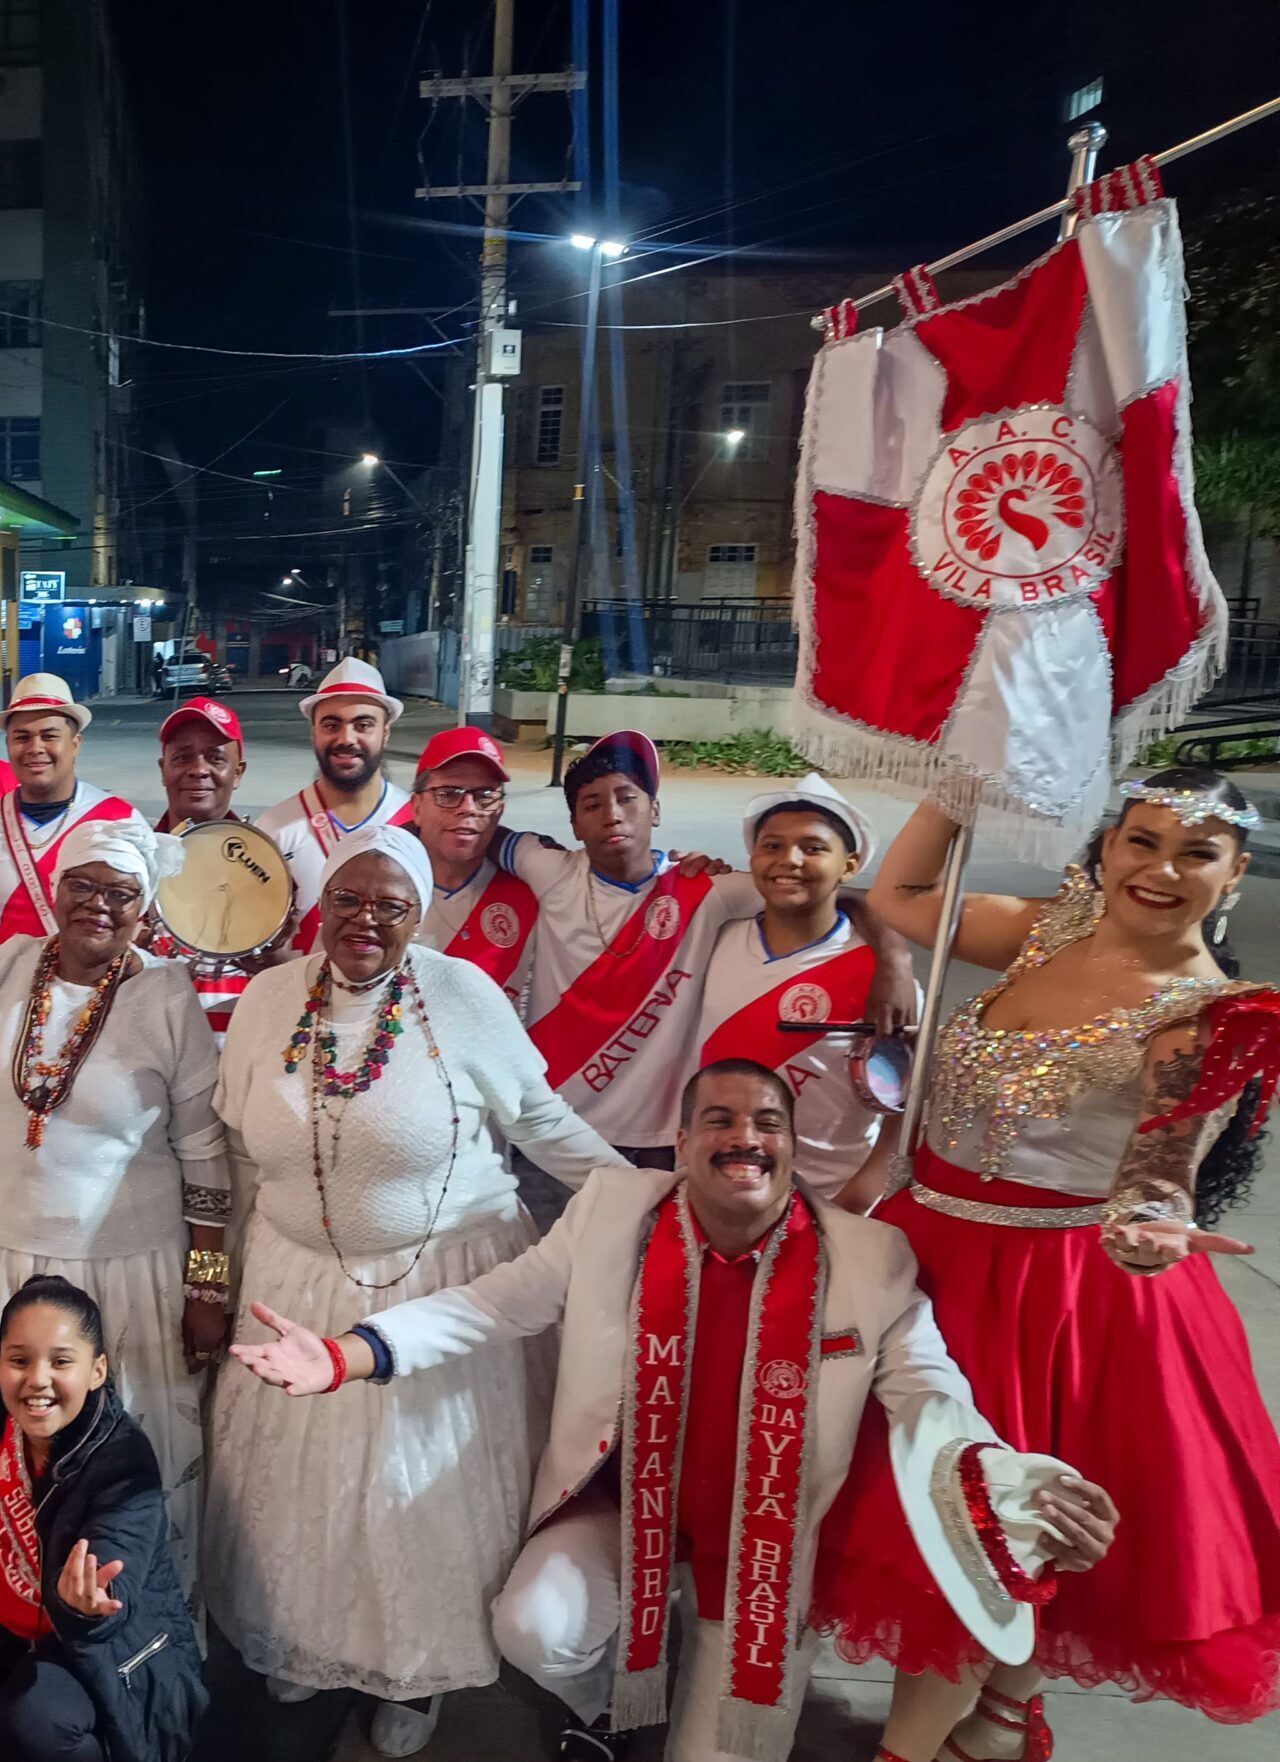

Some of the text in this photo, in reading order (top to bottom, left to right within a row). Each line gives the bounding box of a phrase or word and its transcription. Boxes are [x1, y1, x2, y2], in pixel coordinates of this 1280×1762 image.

[932, 530, 1116, 602] VILA BRASIL
[580, 968, 693, 1093] BATERIA
[759, 1403, 798, 1429] DA
[638, 1332, 682, 1637] MALANDRO
[751, 1430, 797, 1521] VILA
[744, 1537, 783, 1669] BRASIL
